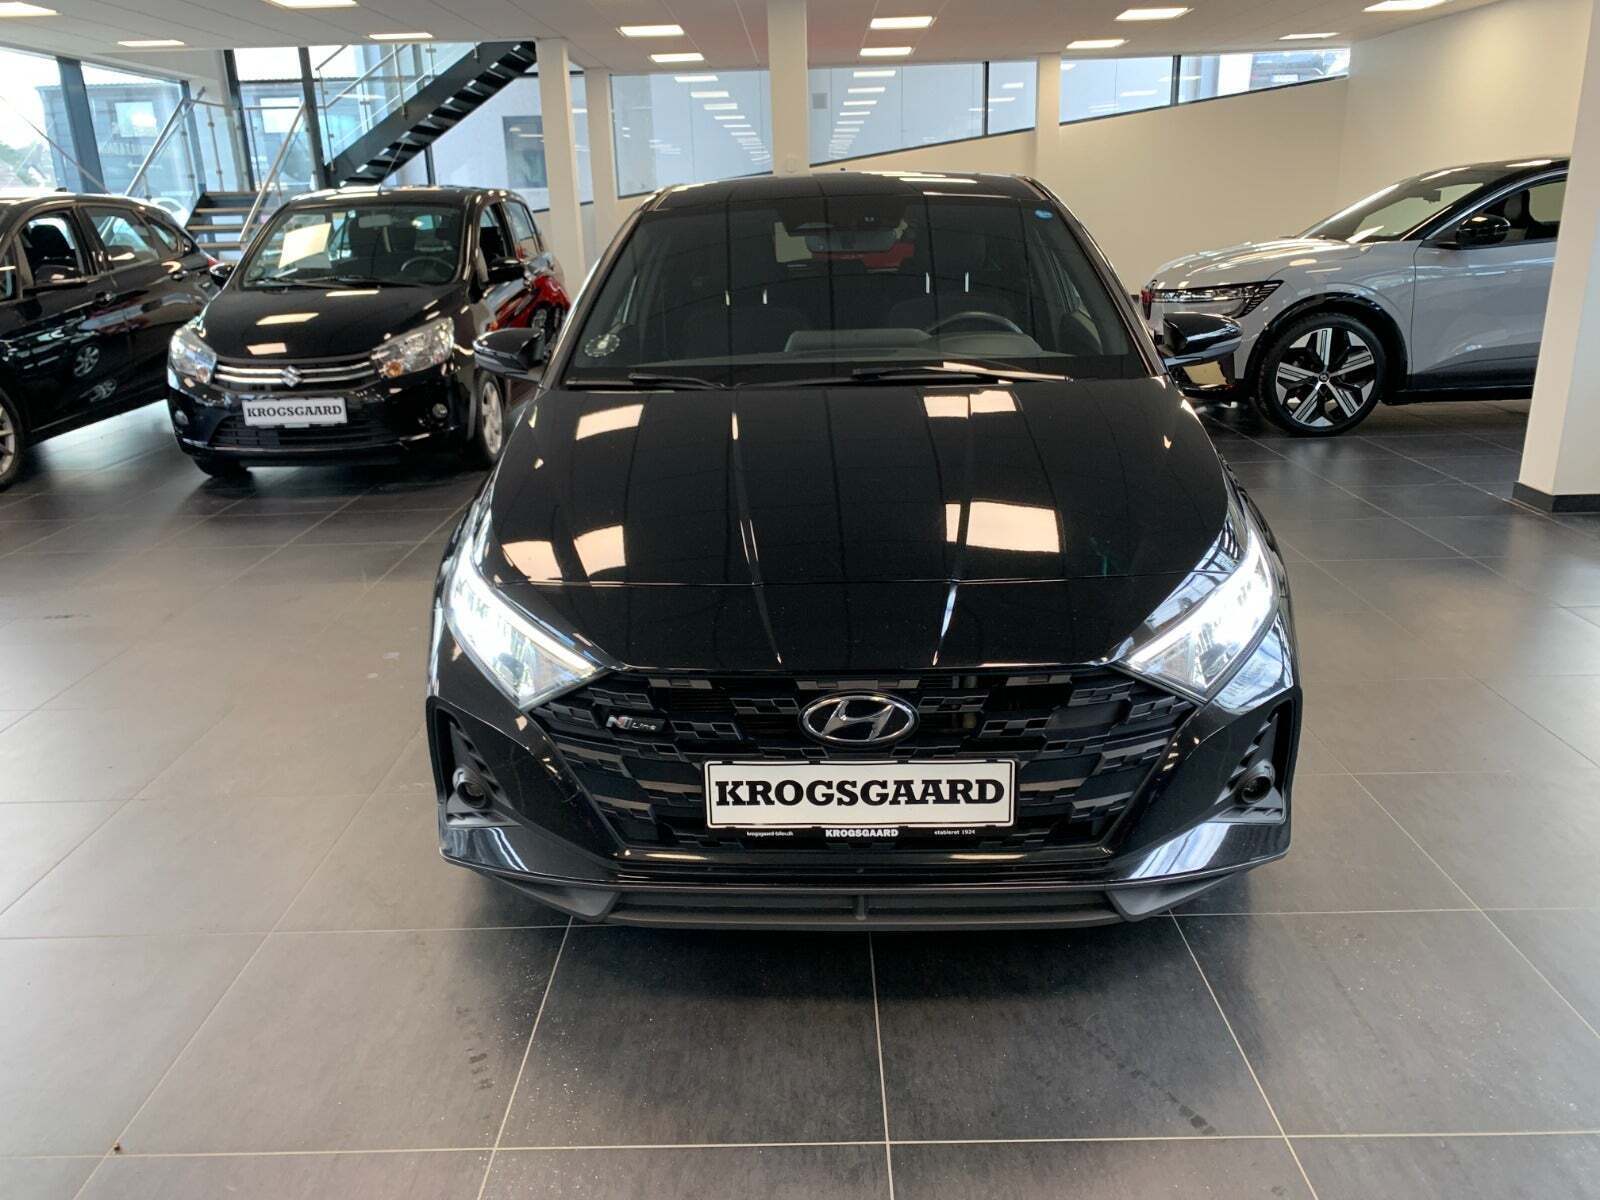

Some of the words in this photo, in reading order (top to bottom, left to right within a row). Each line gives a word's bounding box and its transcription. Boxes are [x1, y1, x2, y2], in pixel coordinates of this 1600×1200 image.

[247, 405, 342, 417] KROGSGAARD
[715, 779, 1005, 806] KROGSGAARD
[825, 829, 899, 837] KROGSGAARD
